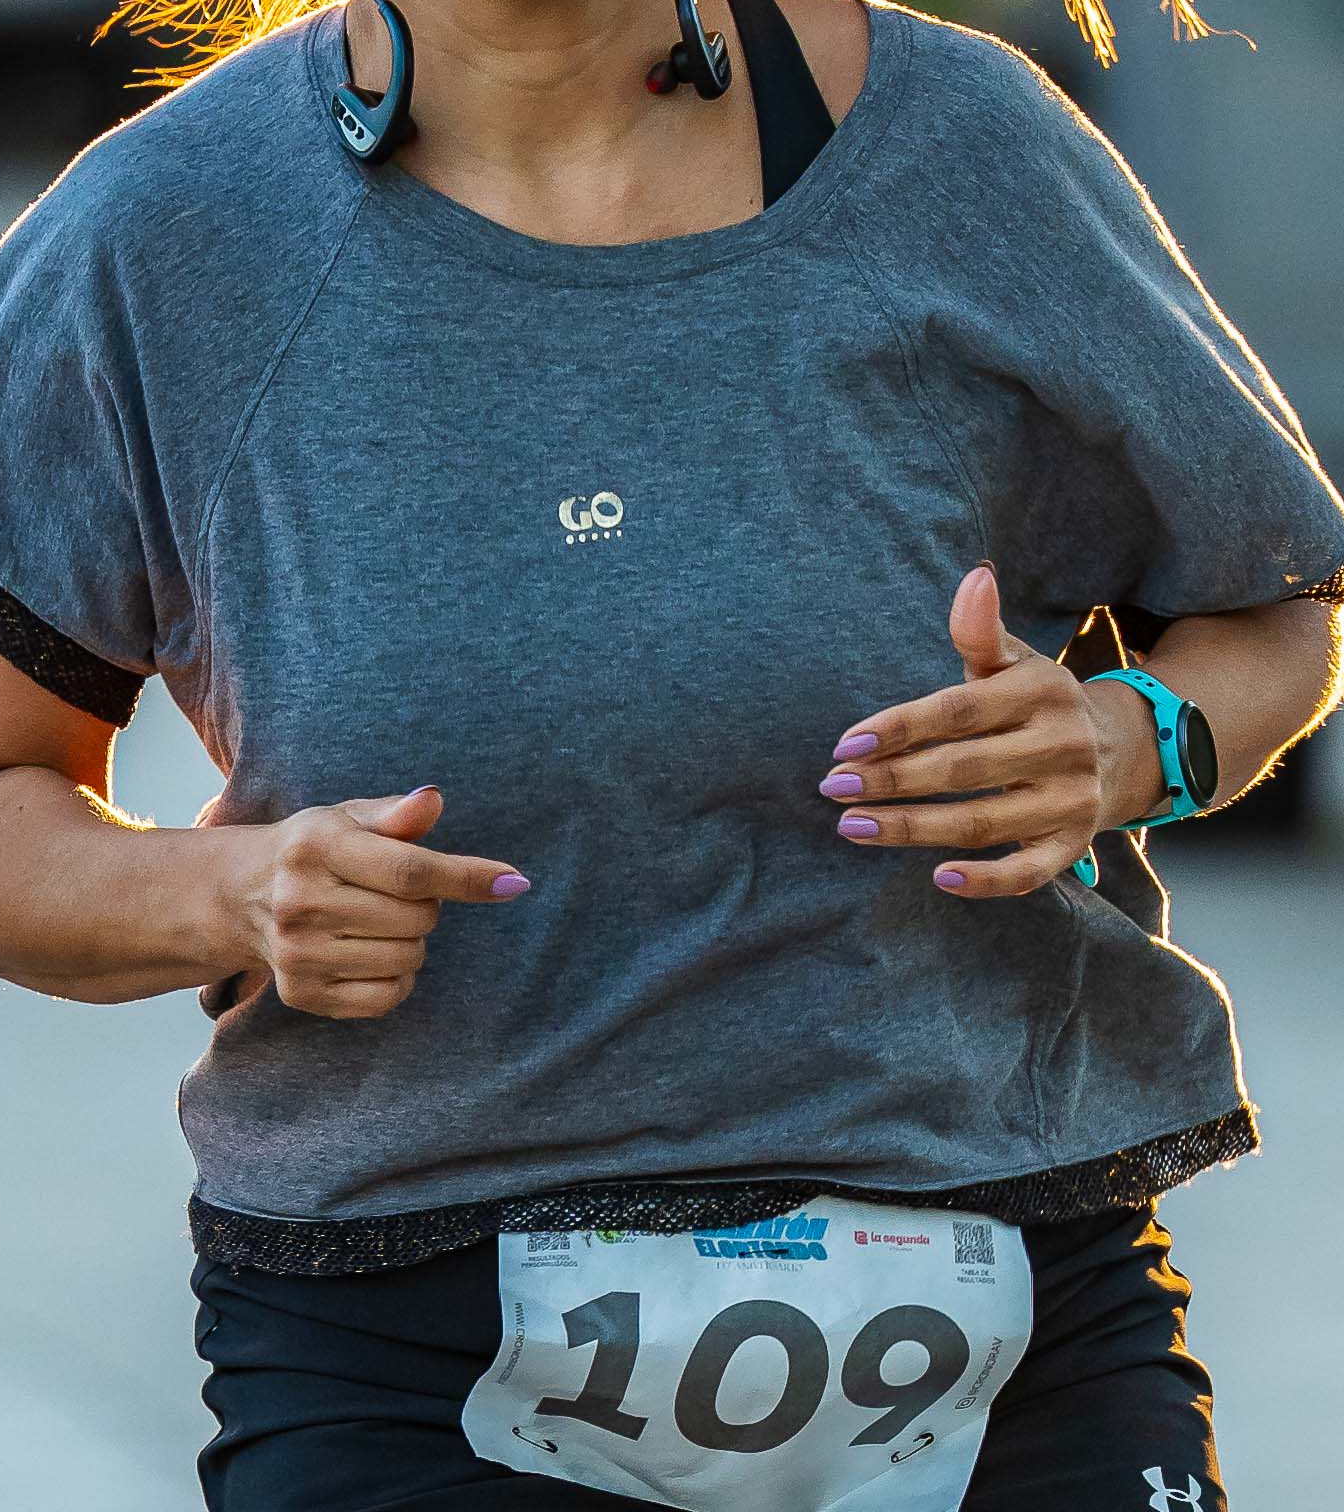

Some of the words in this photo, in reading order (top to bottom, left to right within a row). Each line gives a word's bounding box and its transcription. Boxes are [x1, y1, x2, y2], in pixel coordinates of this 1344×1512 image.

[558, 491, 624, 532] GO
[870, 1231, 882, 1243] la
[883, 1234, 930, 1246] segunda
[533, 1291, 971, 1454] 109
